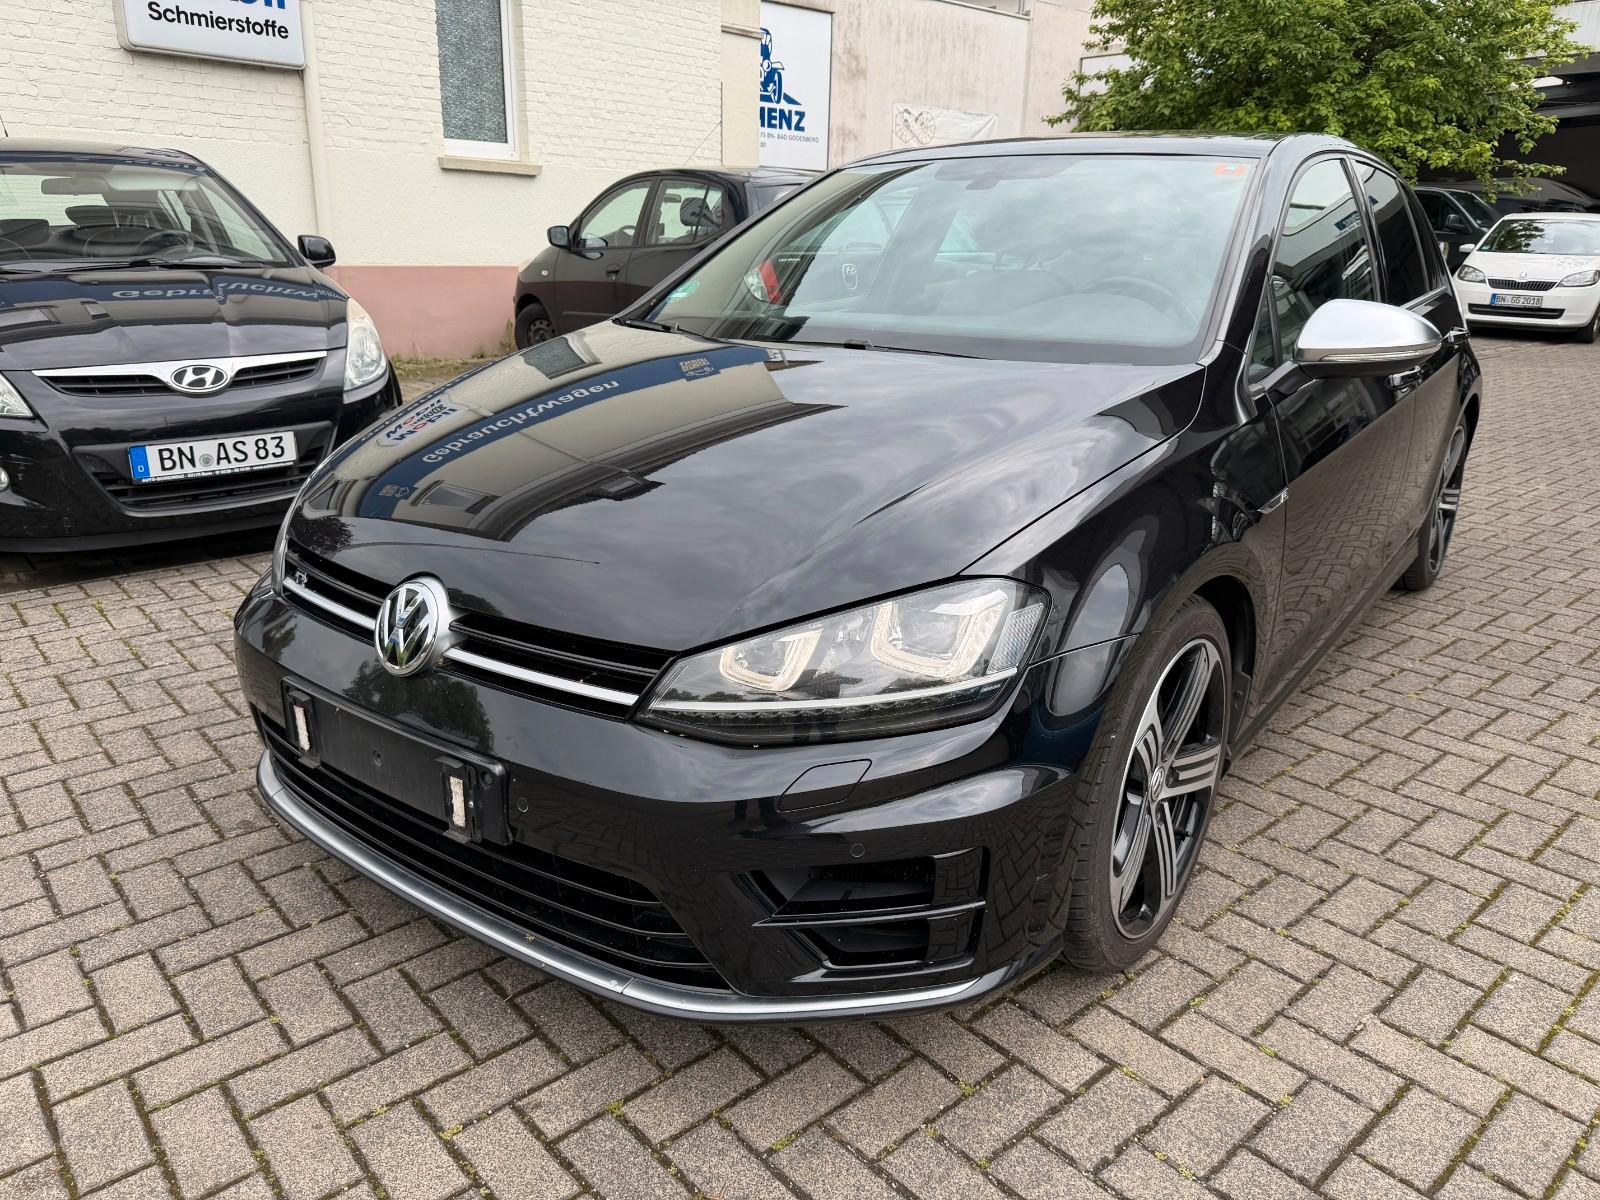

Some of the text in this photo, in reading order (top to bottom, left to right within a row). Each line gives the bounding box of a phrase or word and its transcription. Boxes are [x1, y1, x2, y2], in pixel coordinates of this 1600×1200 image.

[147, 1, 290, 39] Schmierstoffe
[1496, 295, 1506, 303] BN
[1522, 296, 1541, 305] 2018
[158, 436, 286, 472] BN AS 83
[137, 465, 145, 473] D
